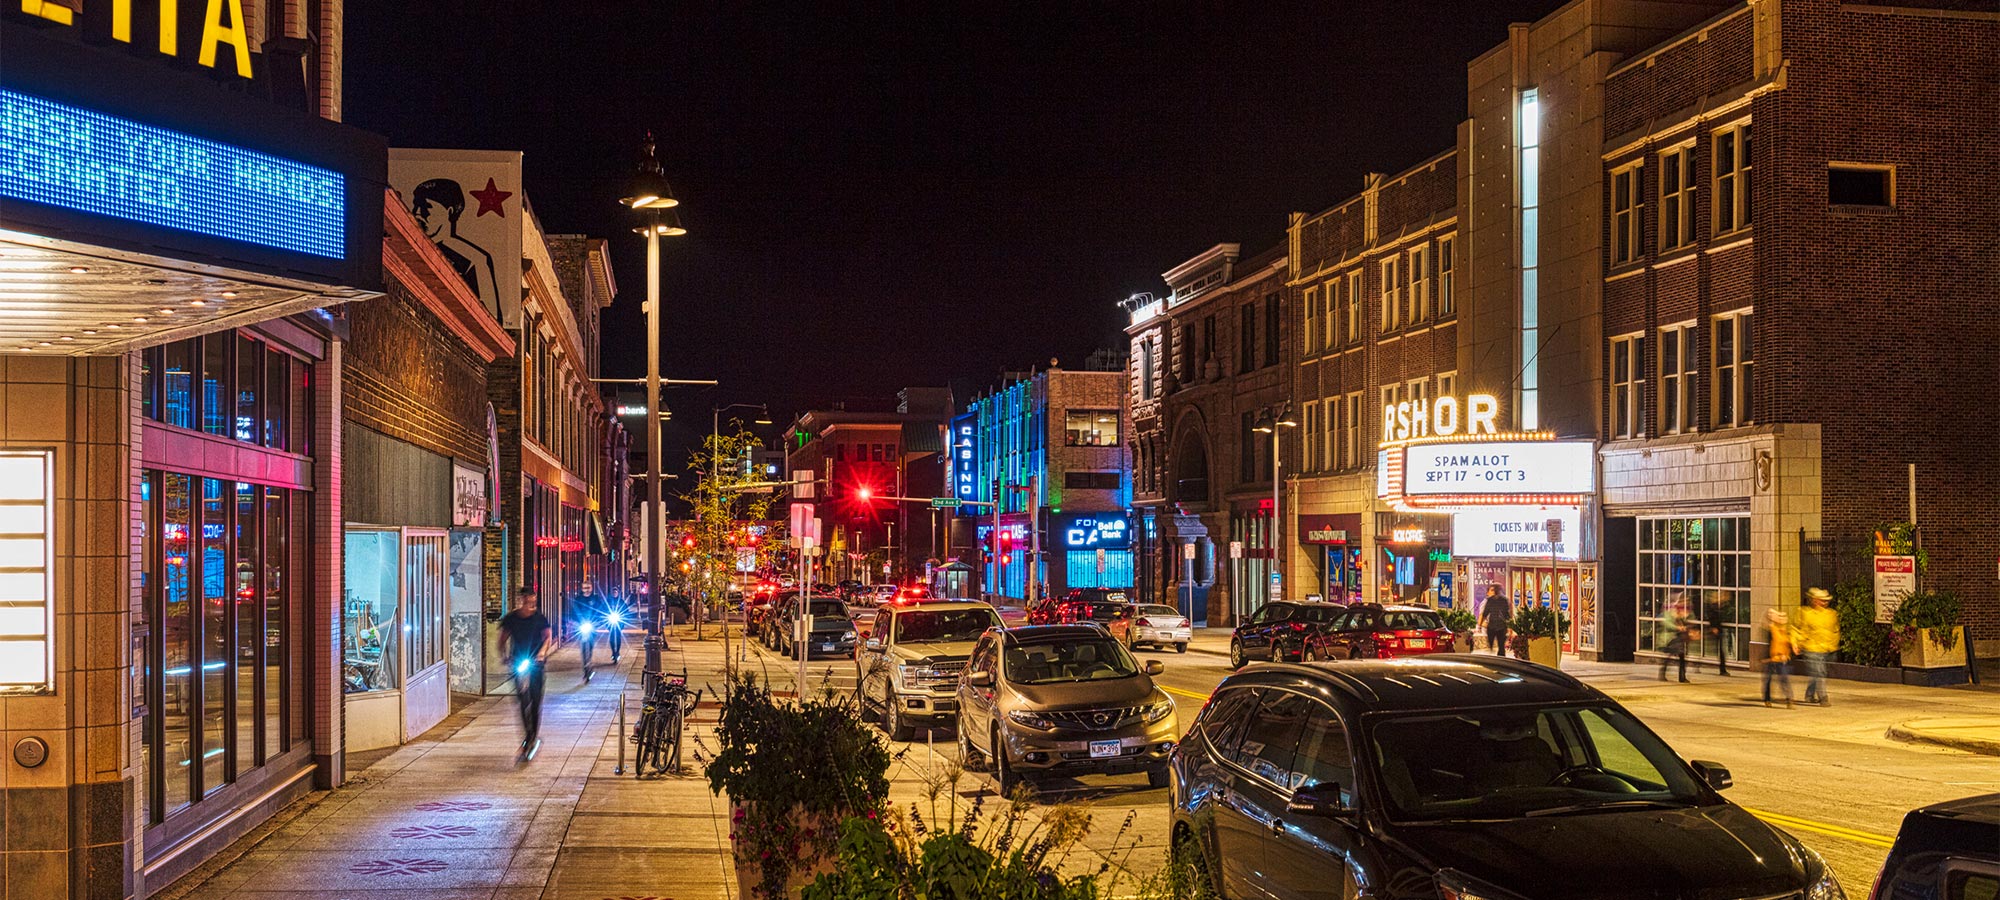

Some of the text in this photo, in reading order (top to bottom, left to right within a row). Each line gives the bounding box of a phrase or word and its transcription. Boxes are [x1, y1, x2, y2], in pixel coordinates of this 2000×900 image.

[119, 129, 212, 181] YOUR
[1384, 394, 1498, 442] RSHOR
[961, 426, 972, 494] CASINO
[1435, 455, 1509, 466] SPAMALOT
[1426, 471, 1450, 481] SEPT
[1455, 470, 1468, 481] 17
[1485, 470, 1512, 481] OCT
[1518, 470, 1526, 481] 3
[1098, 522, 1113, 531] Bell
[1494, 522, 1521, 532] TICKETS
[1525, 522, 1539, 531] NOW
